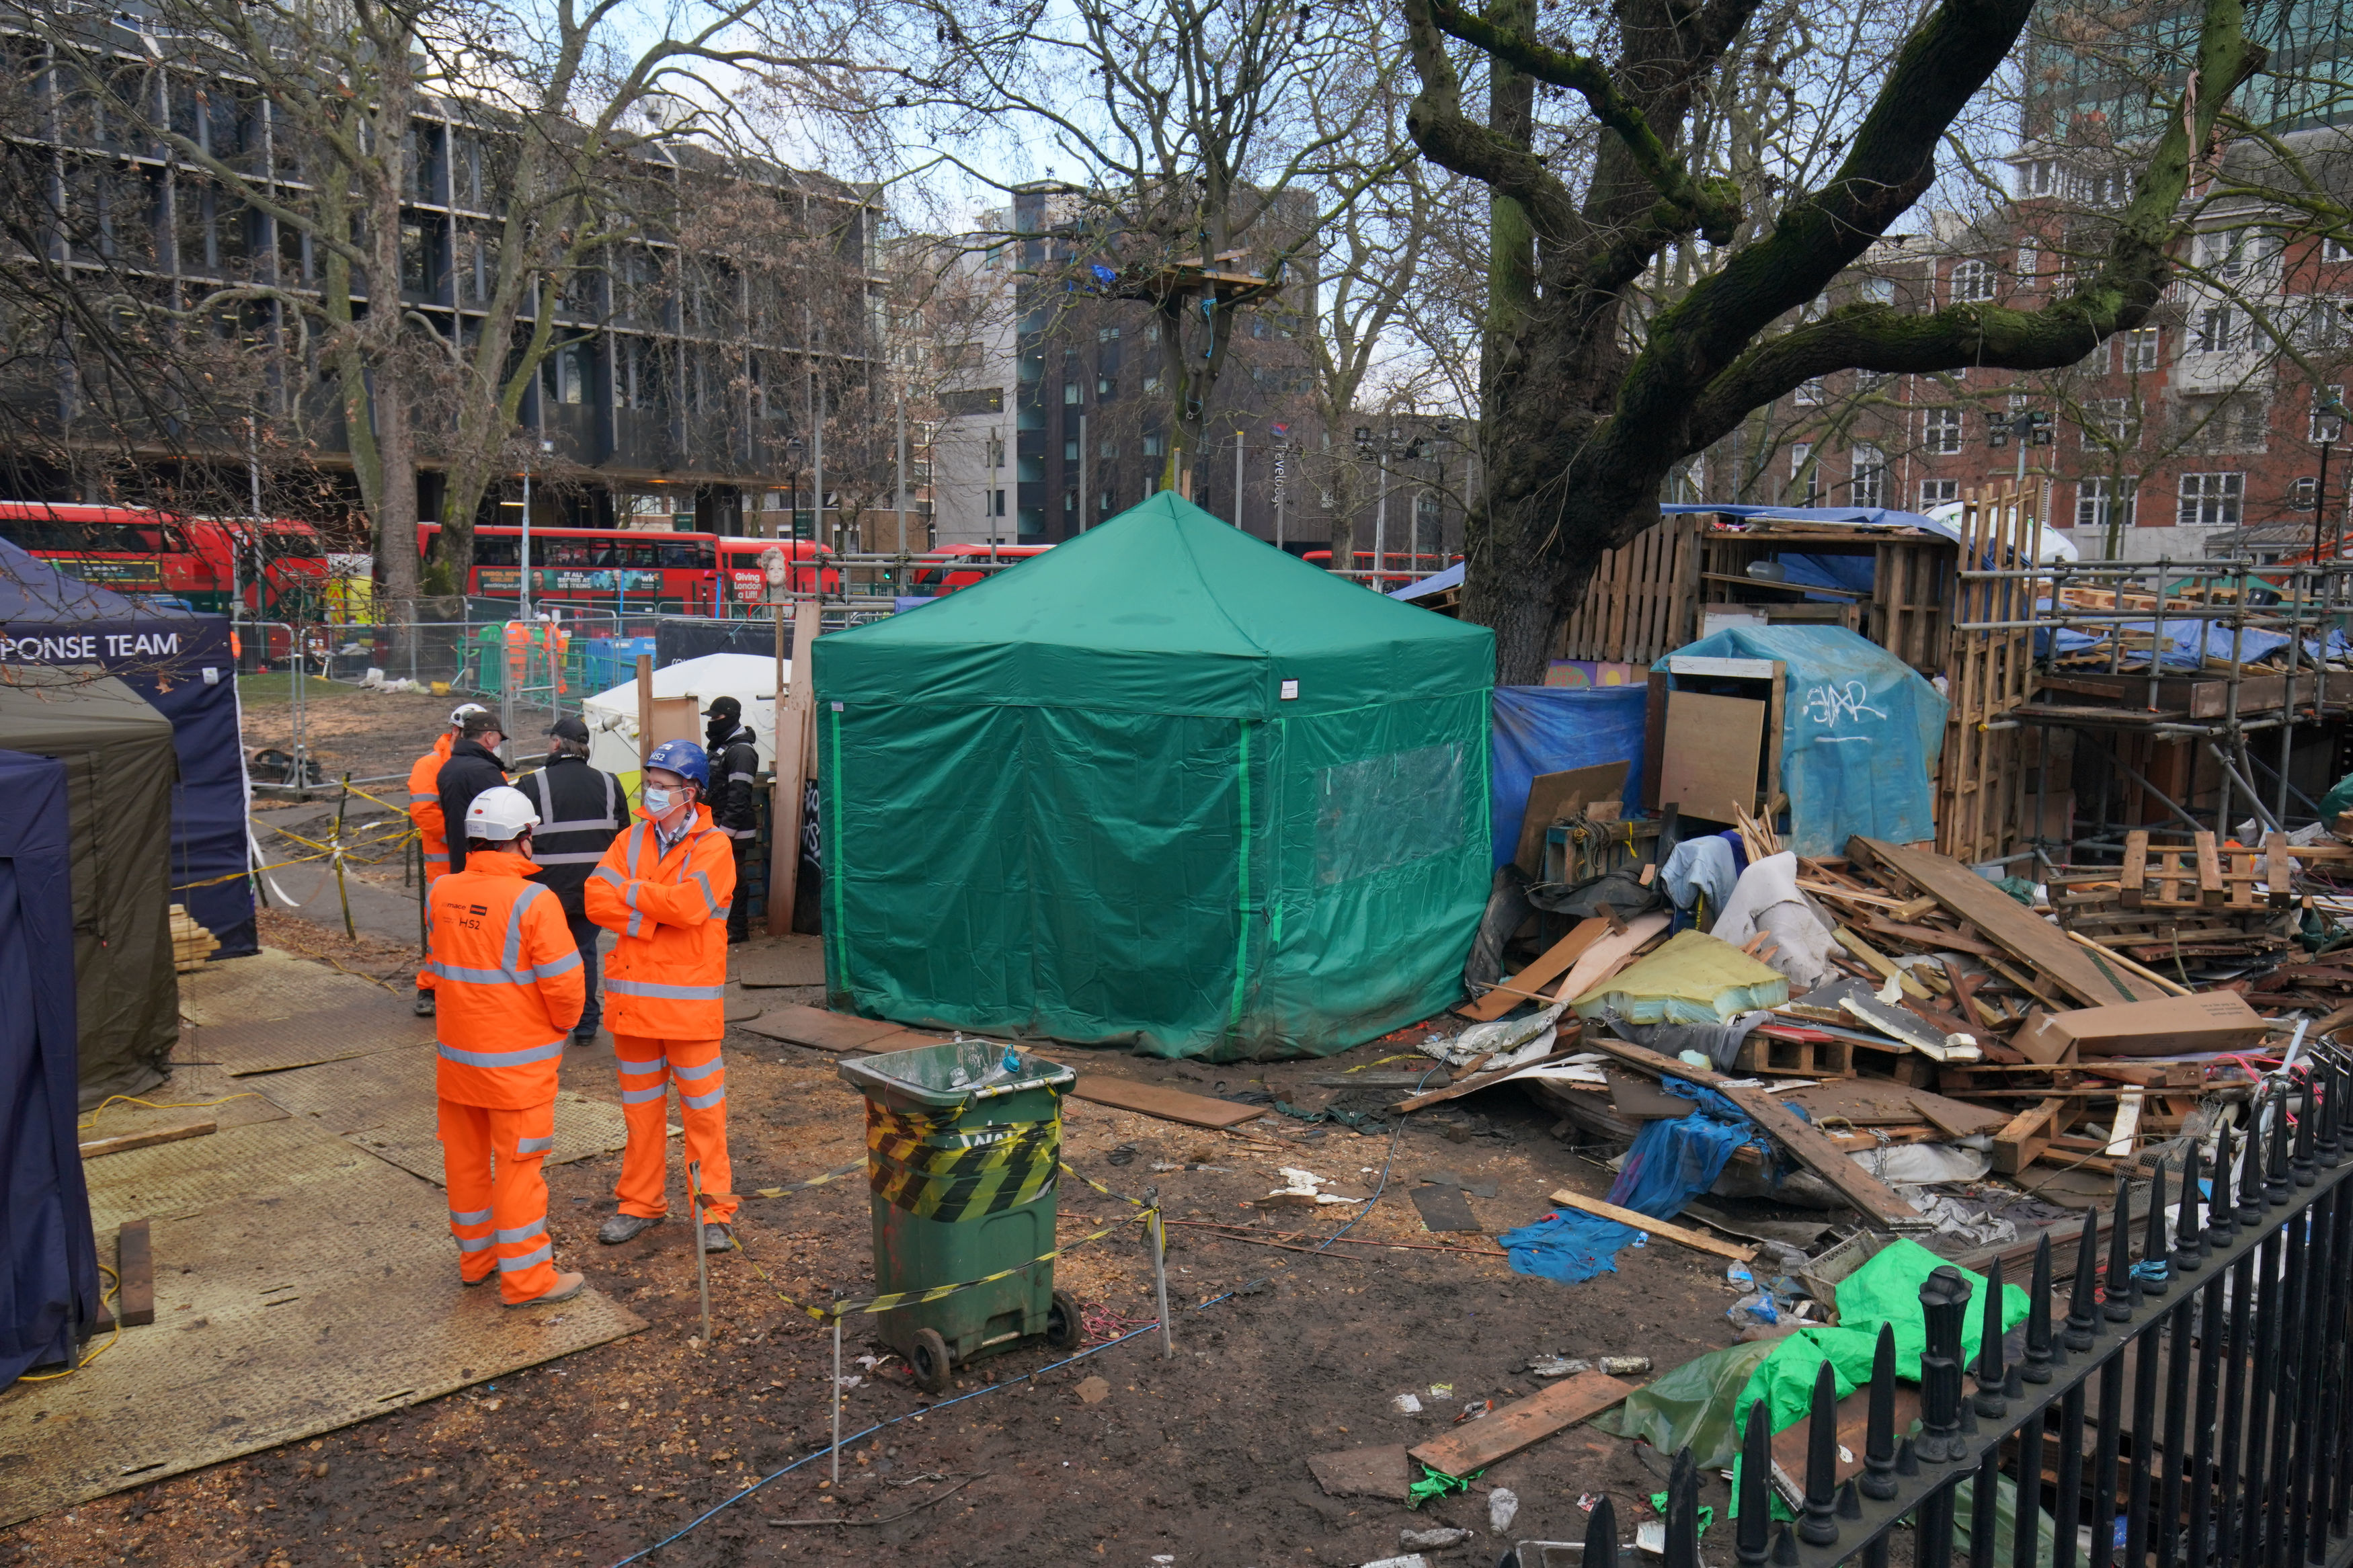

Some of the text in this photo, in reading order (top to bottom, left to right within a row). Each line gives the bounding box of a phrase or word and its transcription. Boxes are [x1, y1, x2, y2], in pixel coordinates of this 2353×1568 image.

[735, 573, 760, 583] Giving
[745, 591, 758, 599] Lift!
[0, 633, 177, 660] PONSE TEAM
[649, 753, 666, 761] HS2
[458, 917, 480, 930] HS2
